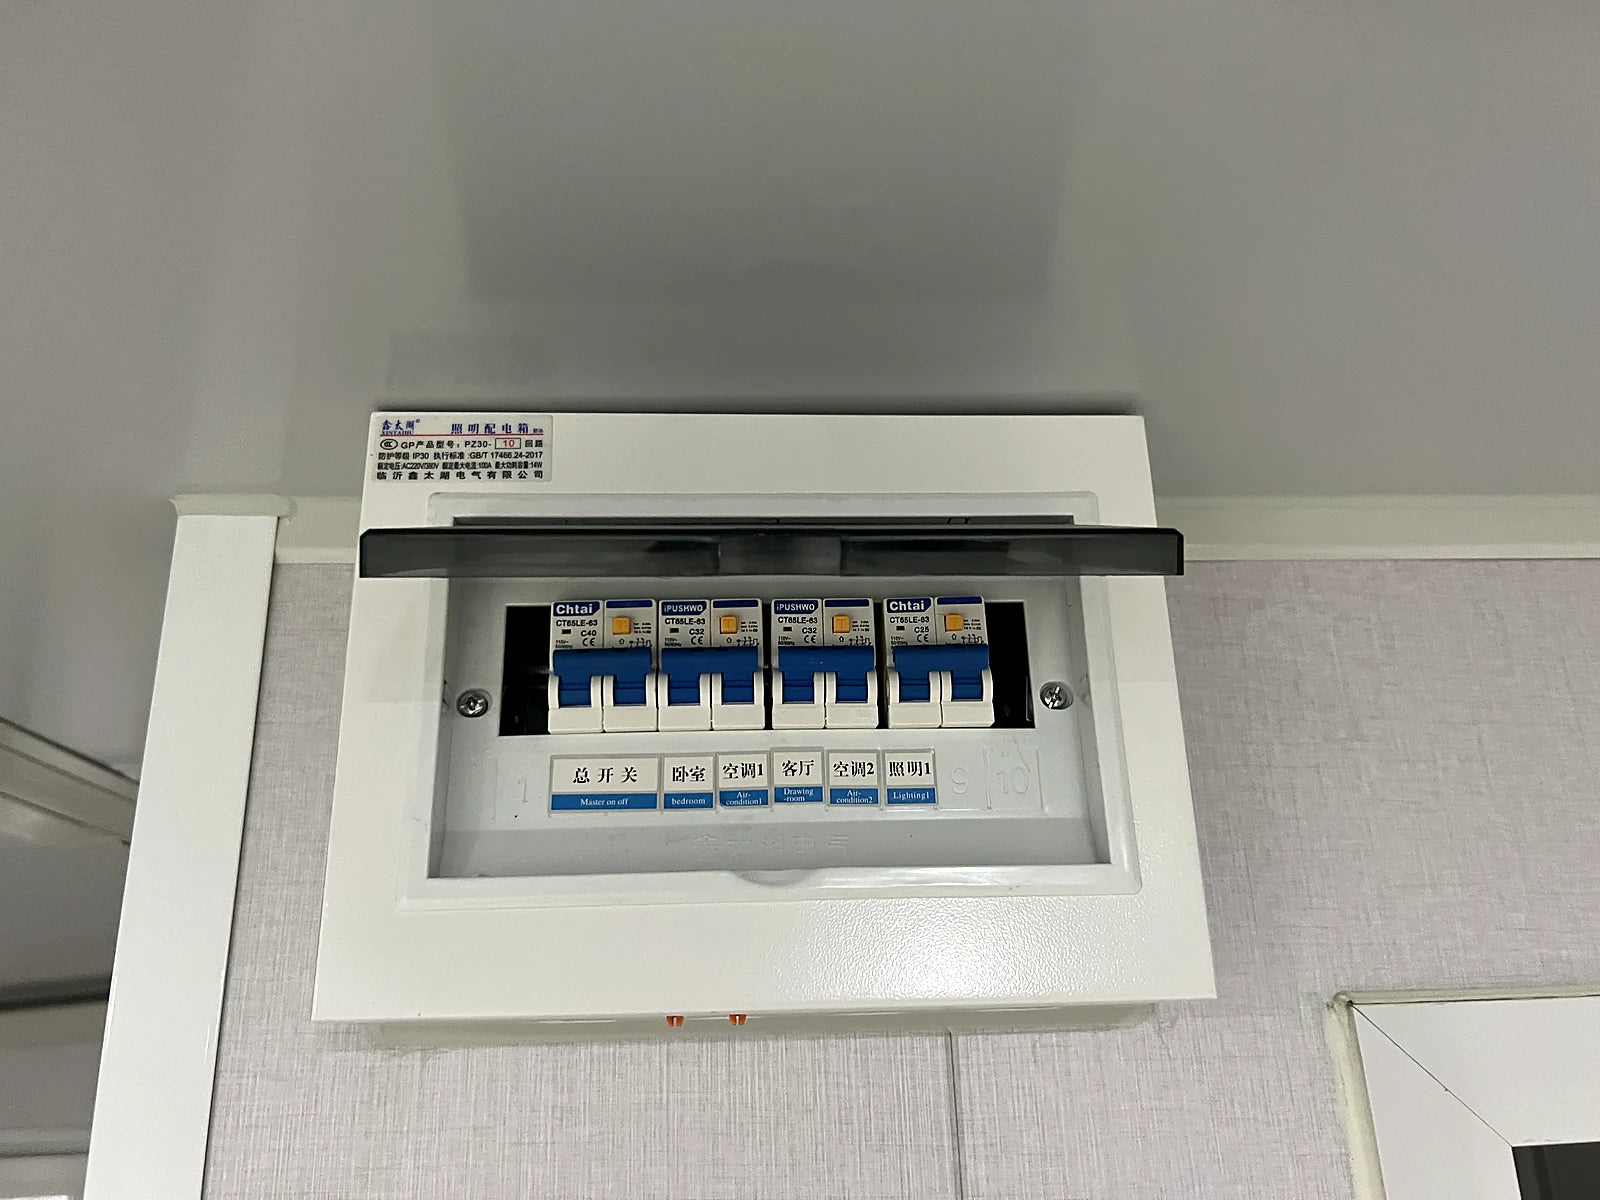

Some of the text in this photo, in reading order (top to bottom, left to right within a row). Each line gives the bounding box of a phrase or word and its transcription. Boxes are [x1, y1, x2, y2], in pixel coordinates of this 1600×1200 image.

[451, 422, 529, 434] 照明配电箱
[503, 439, 515, 447] 10
[412, 452, 430, 460] IP30
[376, 471, 543, 480] 临沂鑫太湖电气有限公司
[556, 604, 593, 614] Chtai
[889, 600, 925, 612] Chtai
[689, 628, 705, 636] C32
[914, 626, 930, 634] C25
[722, 762, 764, 779] 空调1
[781, 760, 815, 777] 客厅
[833, 761, 875, 778] 空调2
[889, 761, 931, 777] 照明1
[573, 766, 638, 784] 总开关
[672, 766, 706, 782] 卧室
[783, 787, 814, 796] Drawing
[846, 789, 861, 797] Air-
[893, 791, 930, 800] Lighting1
[580, 798, 605, 806] Master
[618, 797, 629, 805] off
[672, 797, 706, 806] bedroom
[725, 798, 762, 806] condition1
[836, 796, 873, 804] condition2
